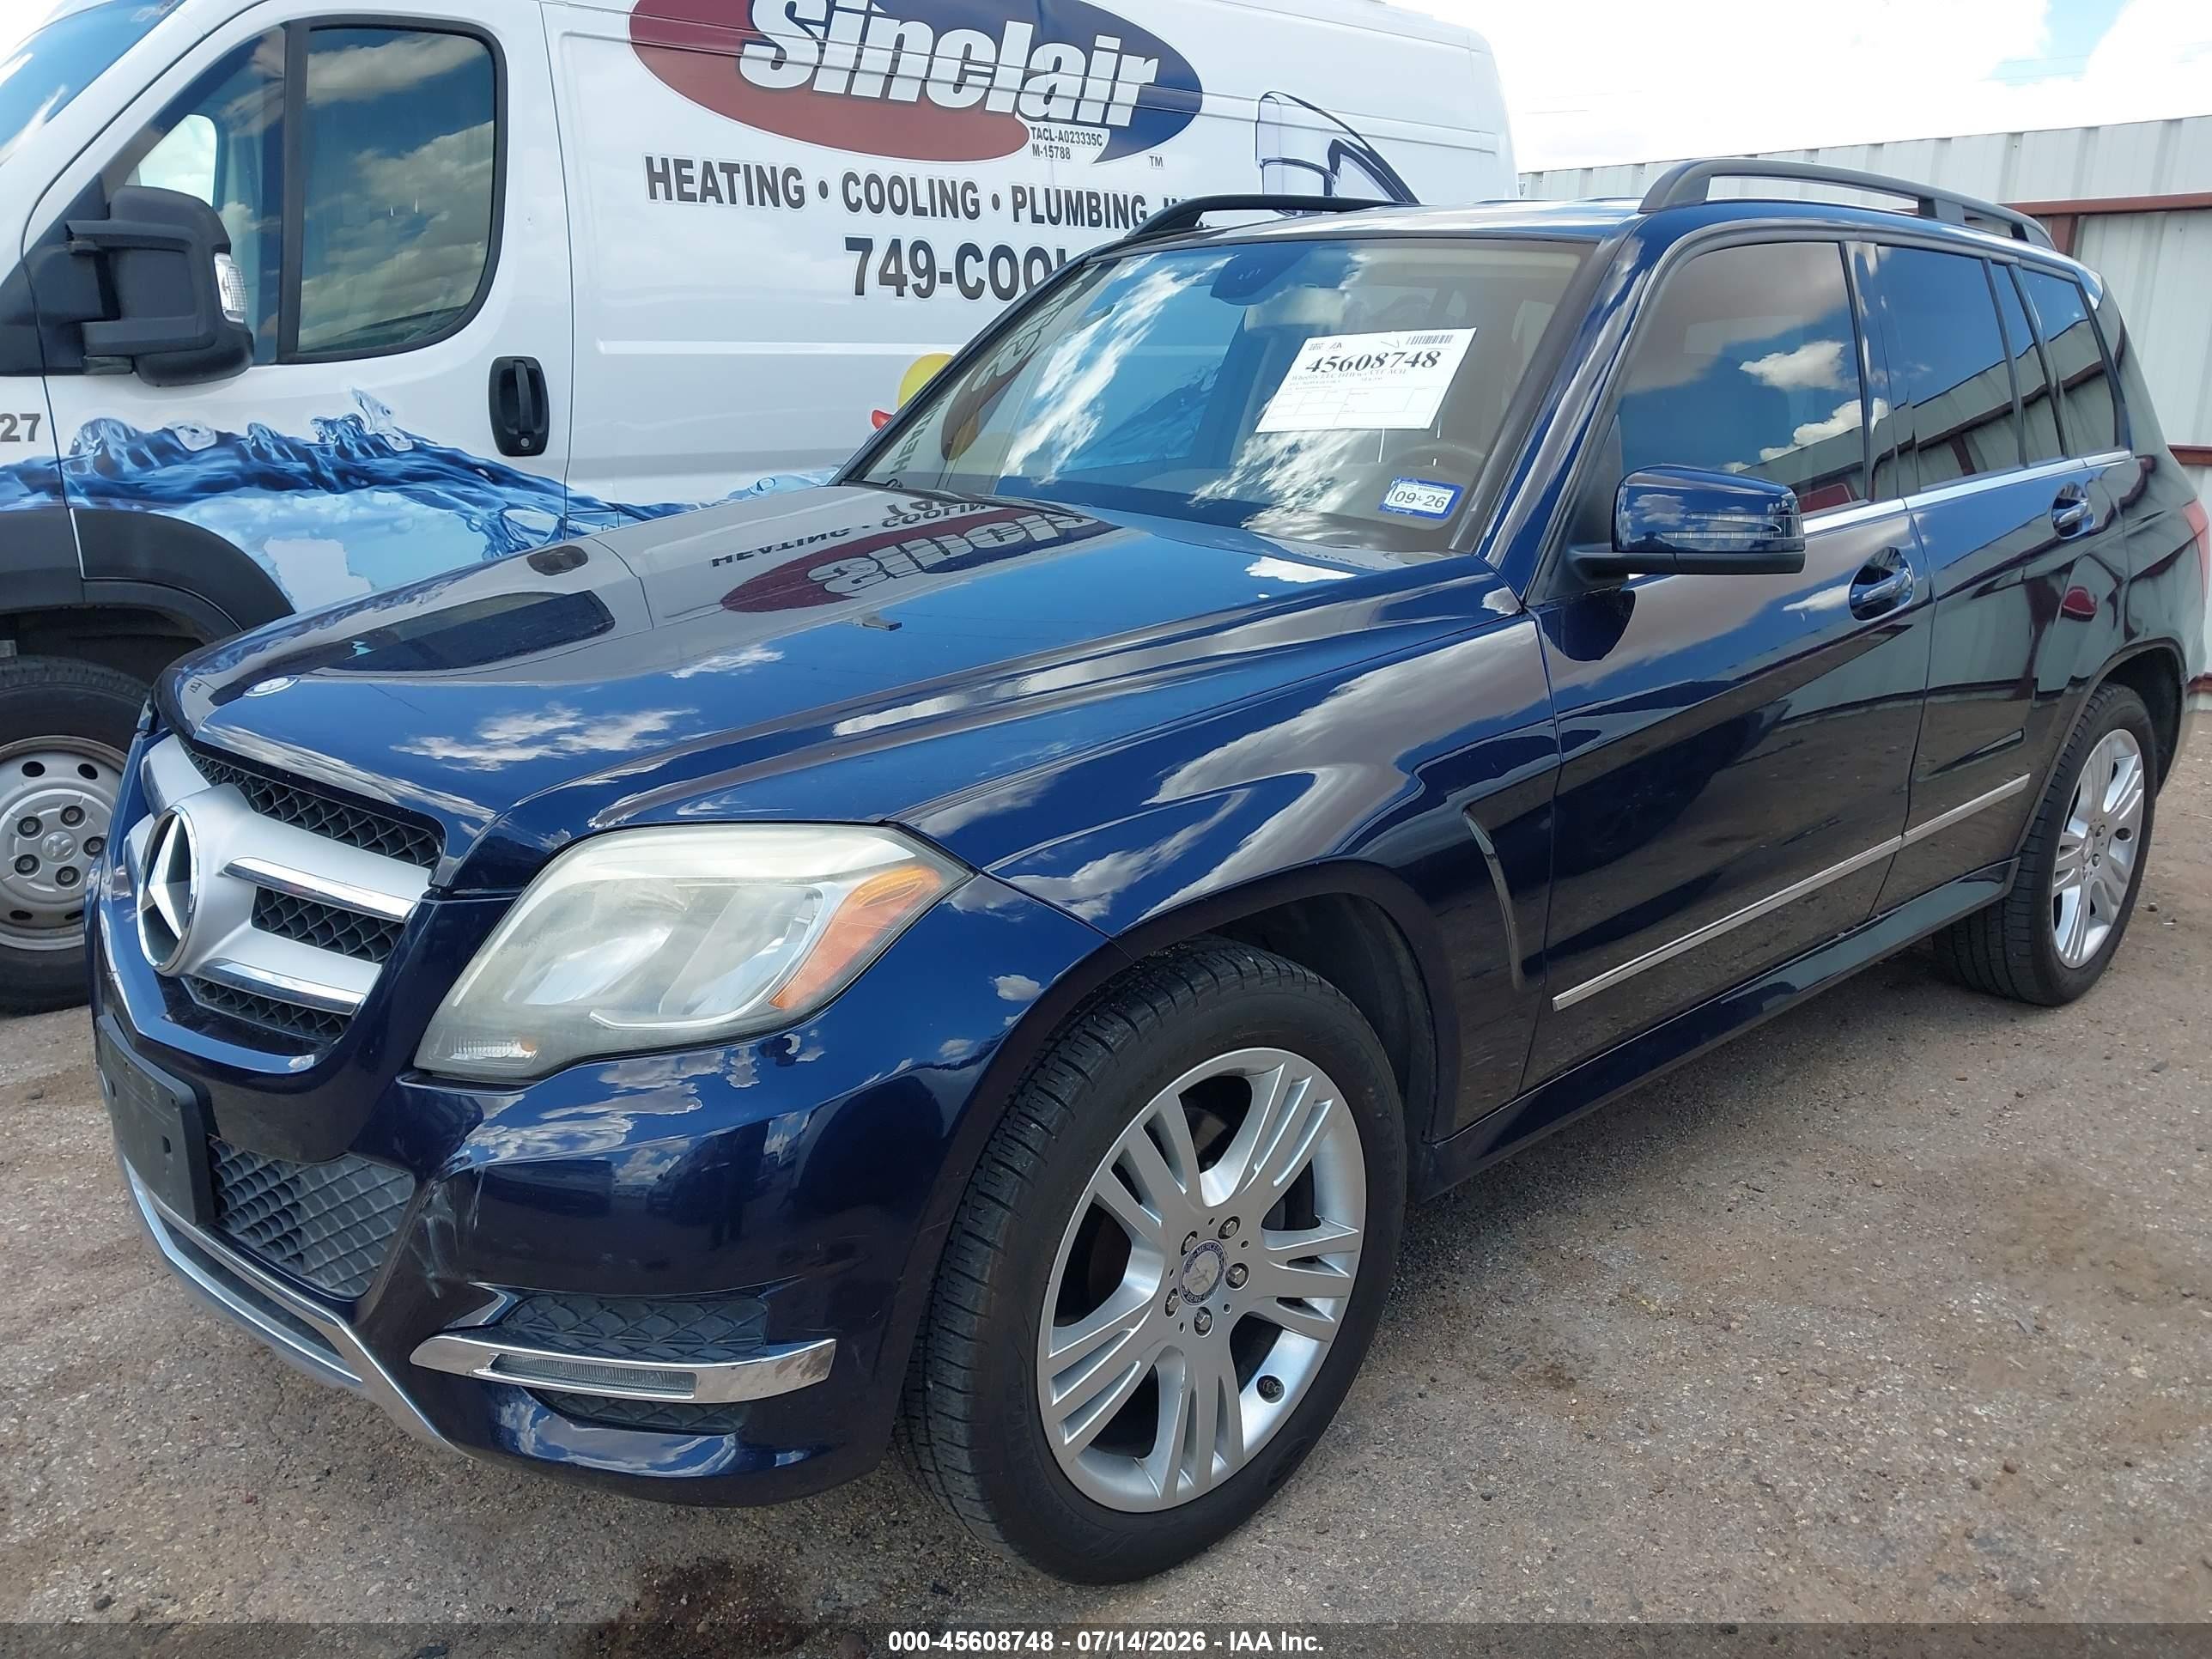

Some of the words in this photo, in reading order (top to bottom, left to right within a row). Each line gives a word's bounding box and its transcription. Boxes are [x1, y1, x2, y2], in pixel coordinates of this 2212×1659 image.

[738, 0, 1159, 127] Sinclair
[1030, 126, 1103, 147] TACL-A023335C
[1031, 143, 1071, 160] M-15788
[645, 155, 805, 210] HEATING
[842, 171, 981, 221] COOLING
[1011, 185, 1147, 230] PLUMBING
[1305, 350, 1442, 374] 45608748
